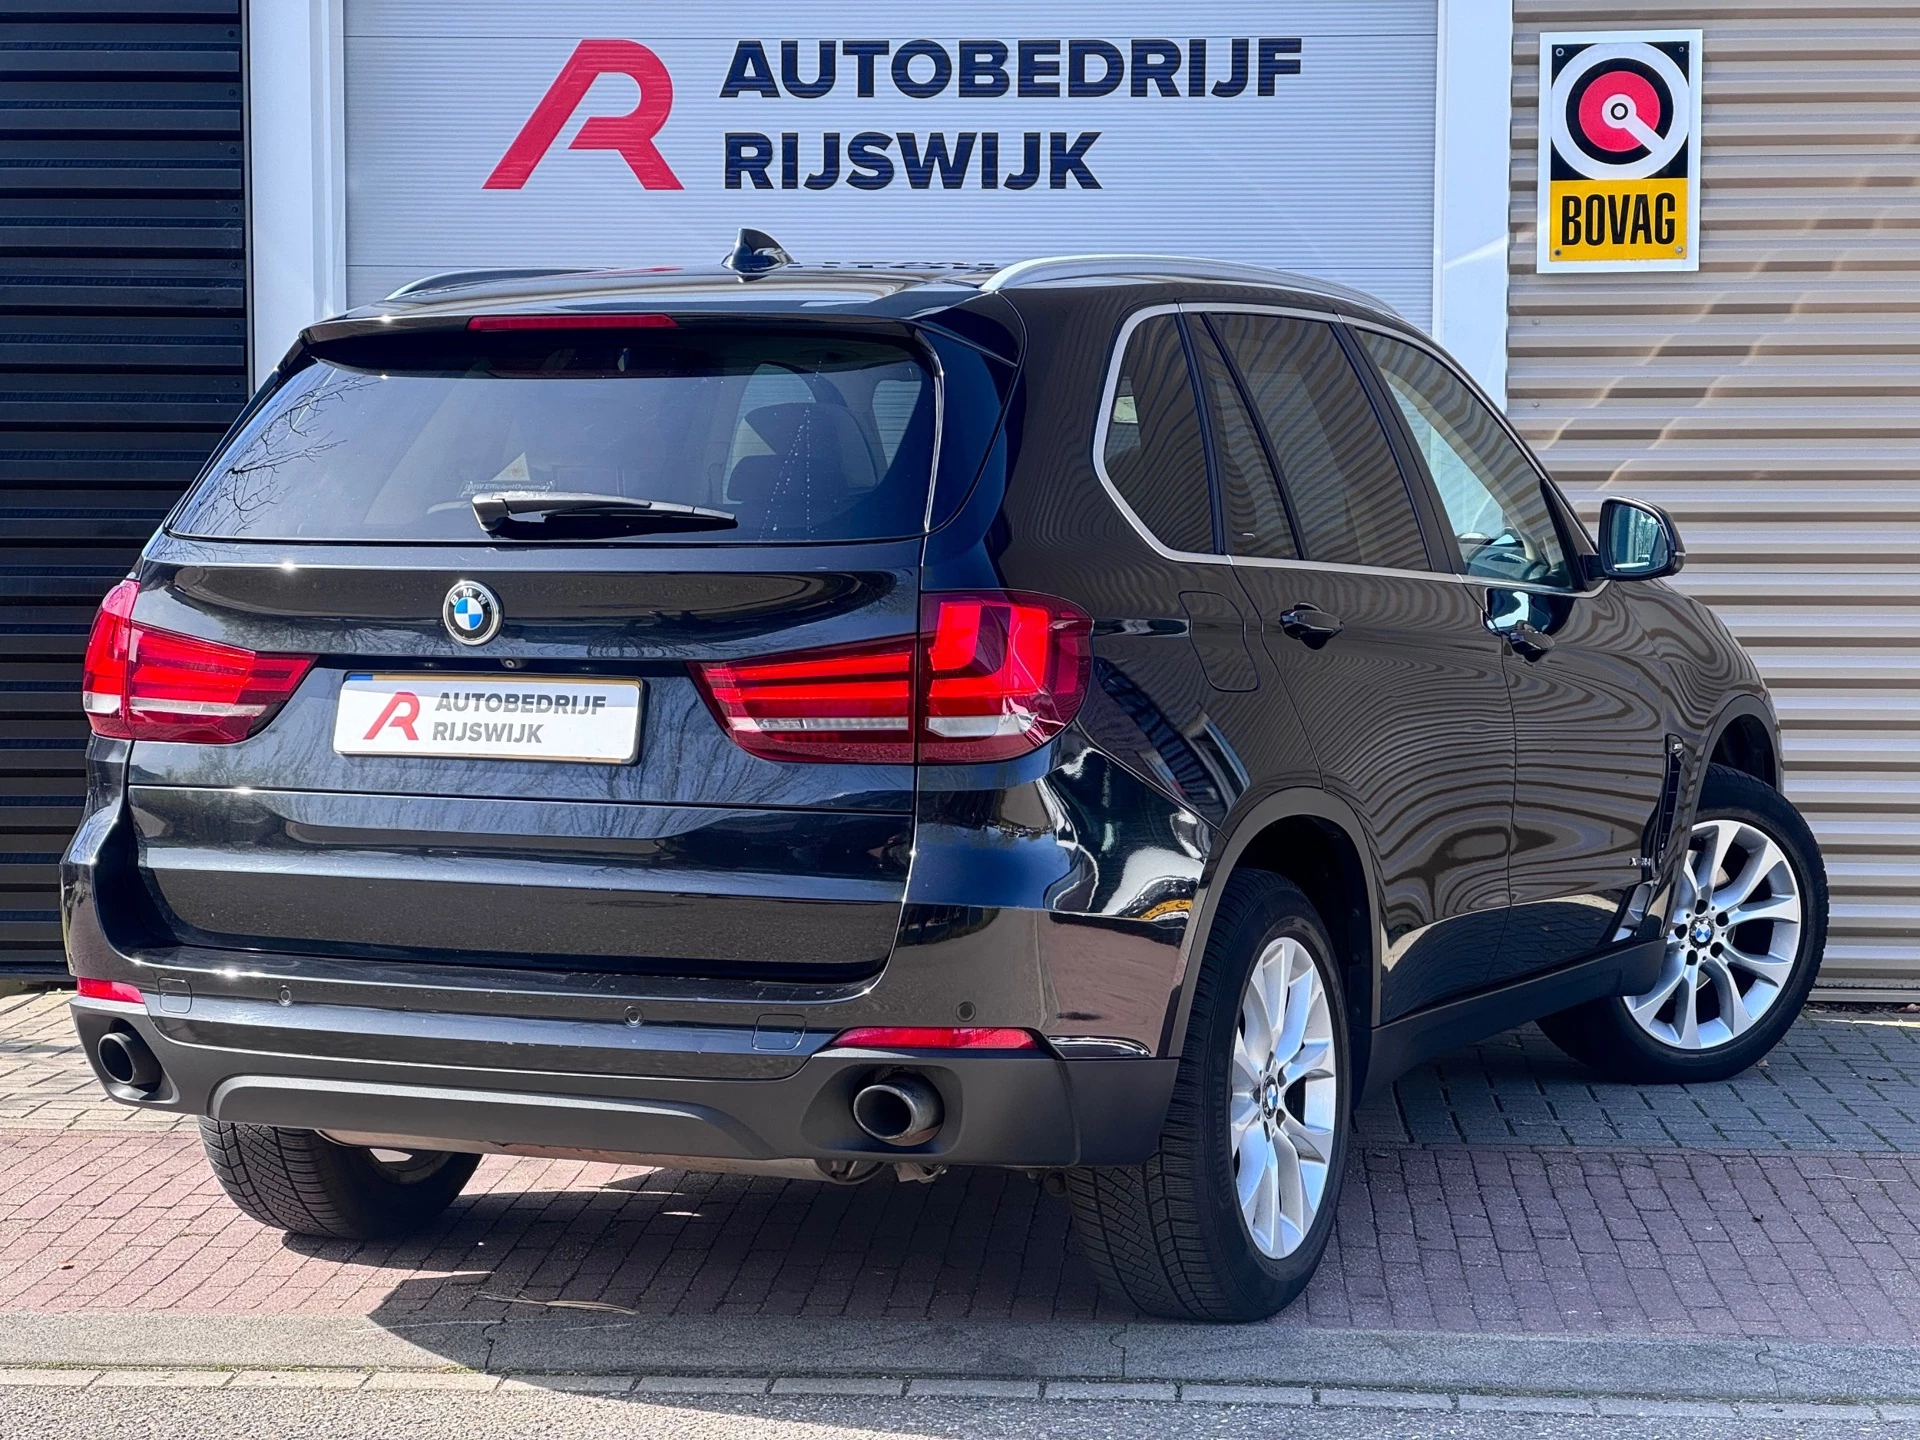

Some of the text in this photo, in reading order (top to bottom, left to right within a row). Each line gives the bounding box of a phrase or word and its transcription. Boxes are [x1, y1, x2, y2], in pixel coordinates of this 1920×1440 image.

[720, 39, 1302, 98] AUTOBEDRIJF
[725, 131, 1103, 190] RIJSWIJK
[1562, 193, 1676, 246] BOVAG
[450, 588, 488, 606] BMW
[435, 692, 607, 715] AUTOBEDRIJF
[432, 721, 544, 744] RIJSWIJK
